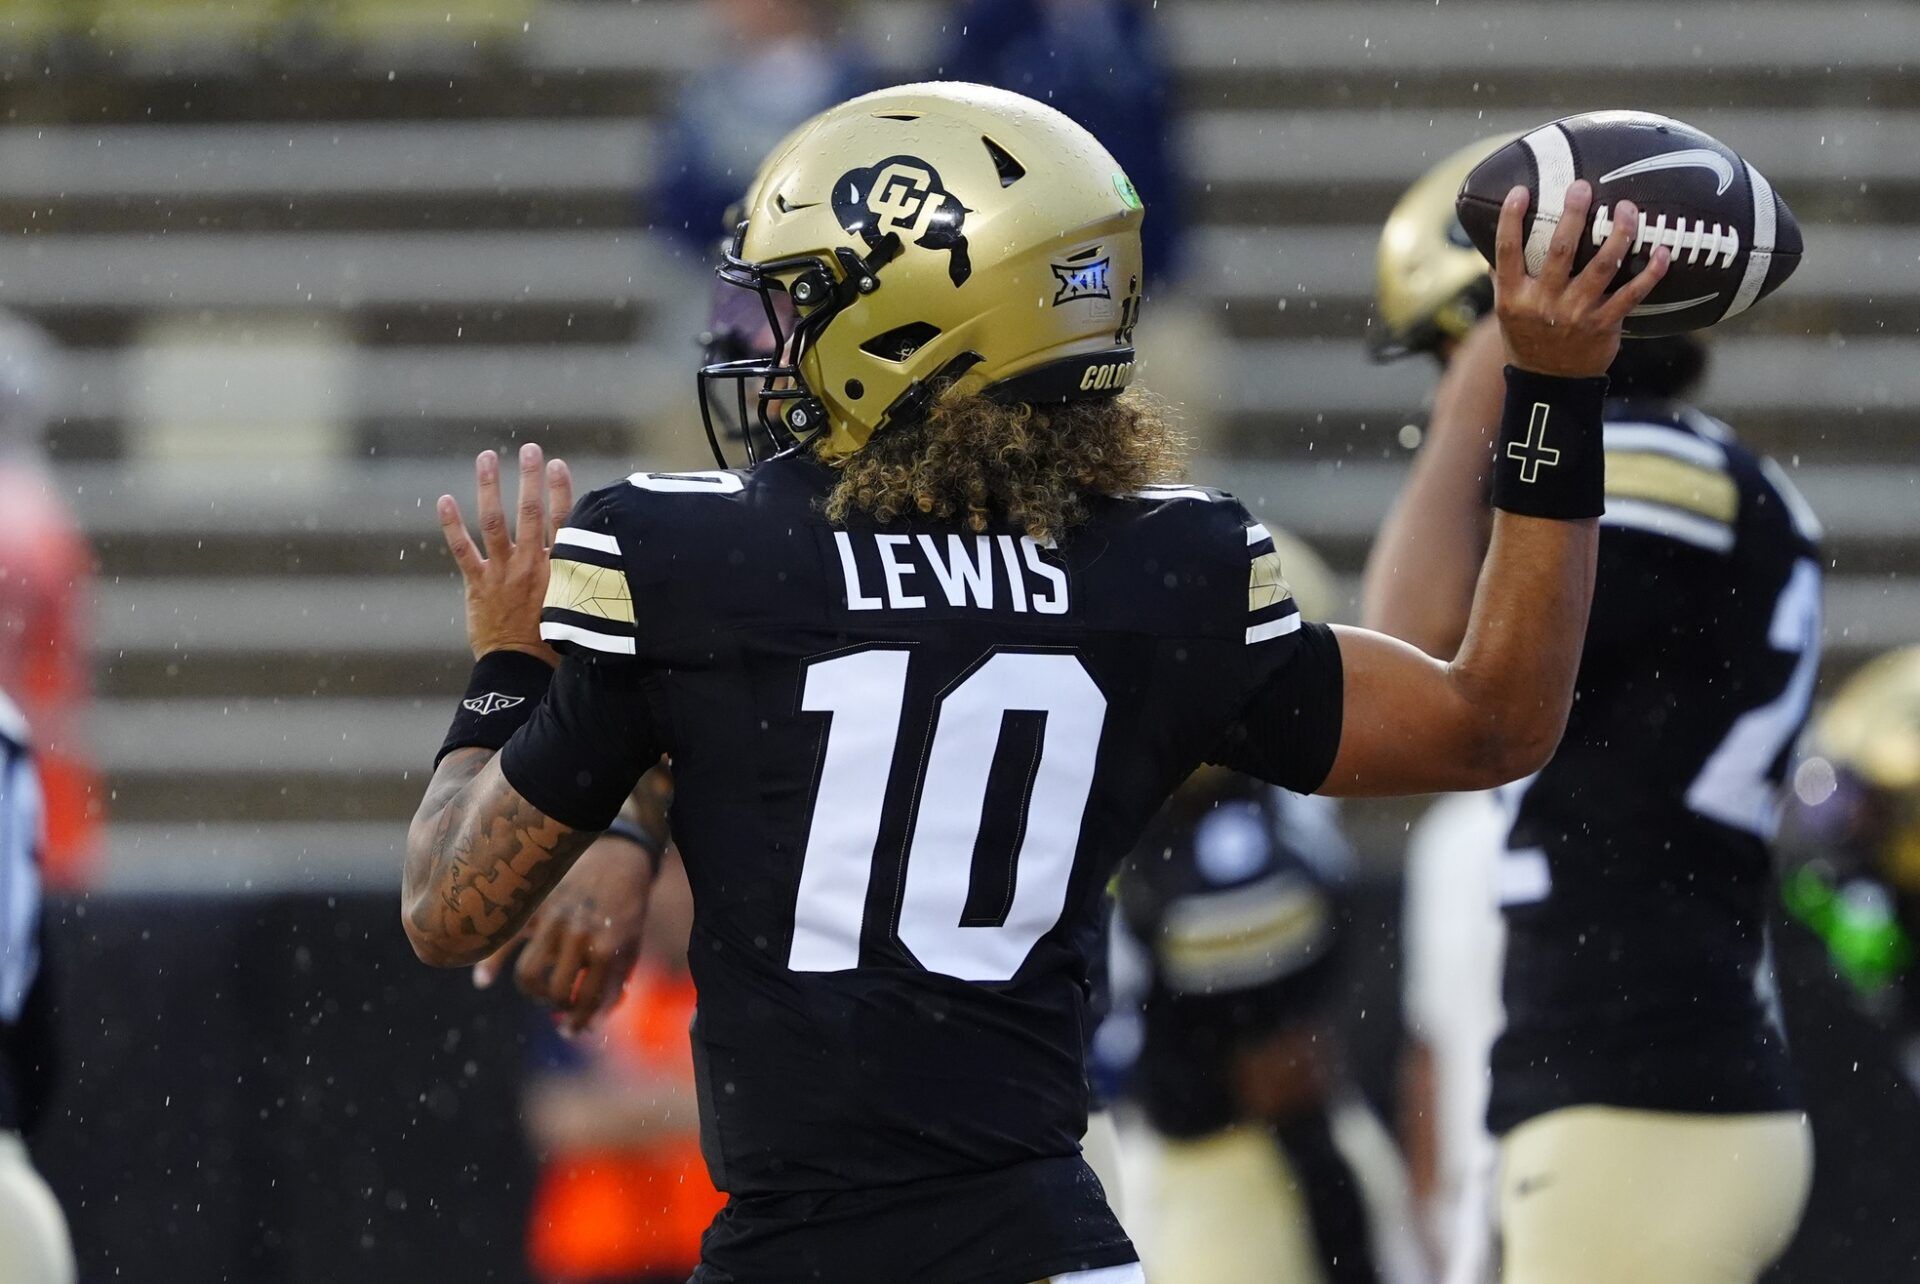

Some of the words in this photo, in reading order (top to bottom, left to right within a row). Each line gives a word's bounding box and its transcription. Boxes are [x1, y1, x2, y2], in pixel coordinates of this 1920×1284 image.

[866, 163, 946, 237] CU
[833, 531, 1070, 615] LEWIS
[787, 649, 1108, 982] 10
